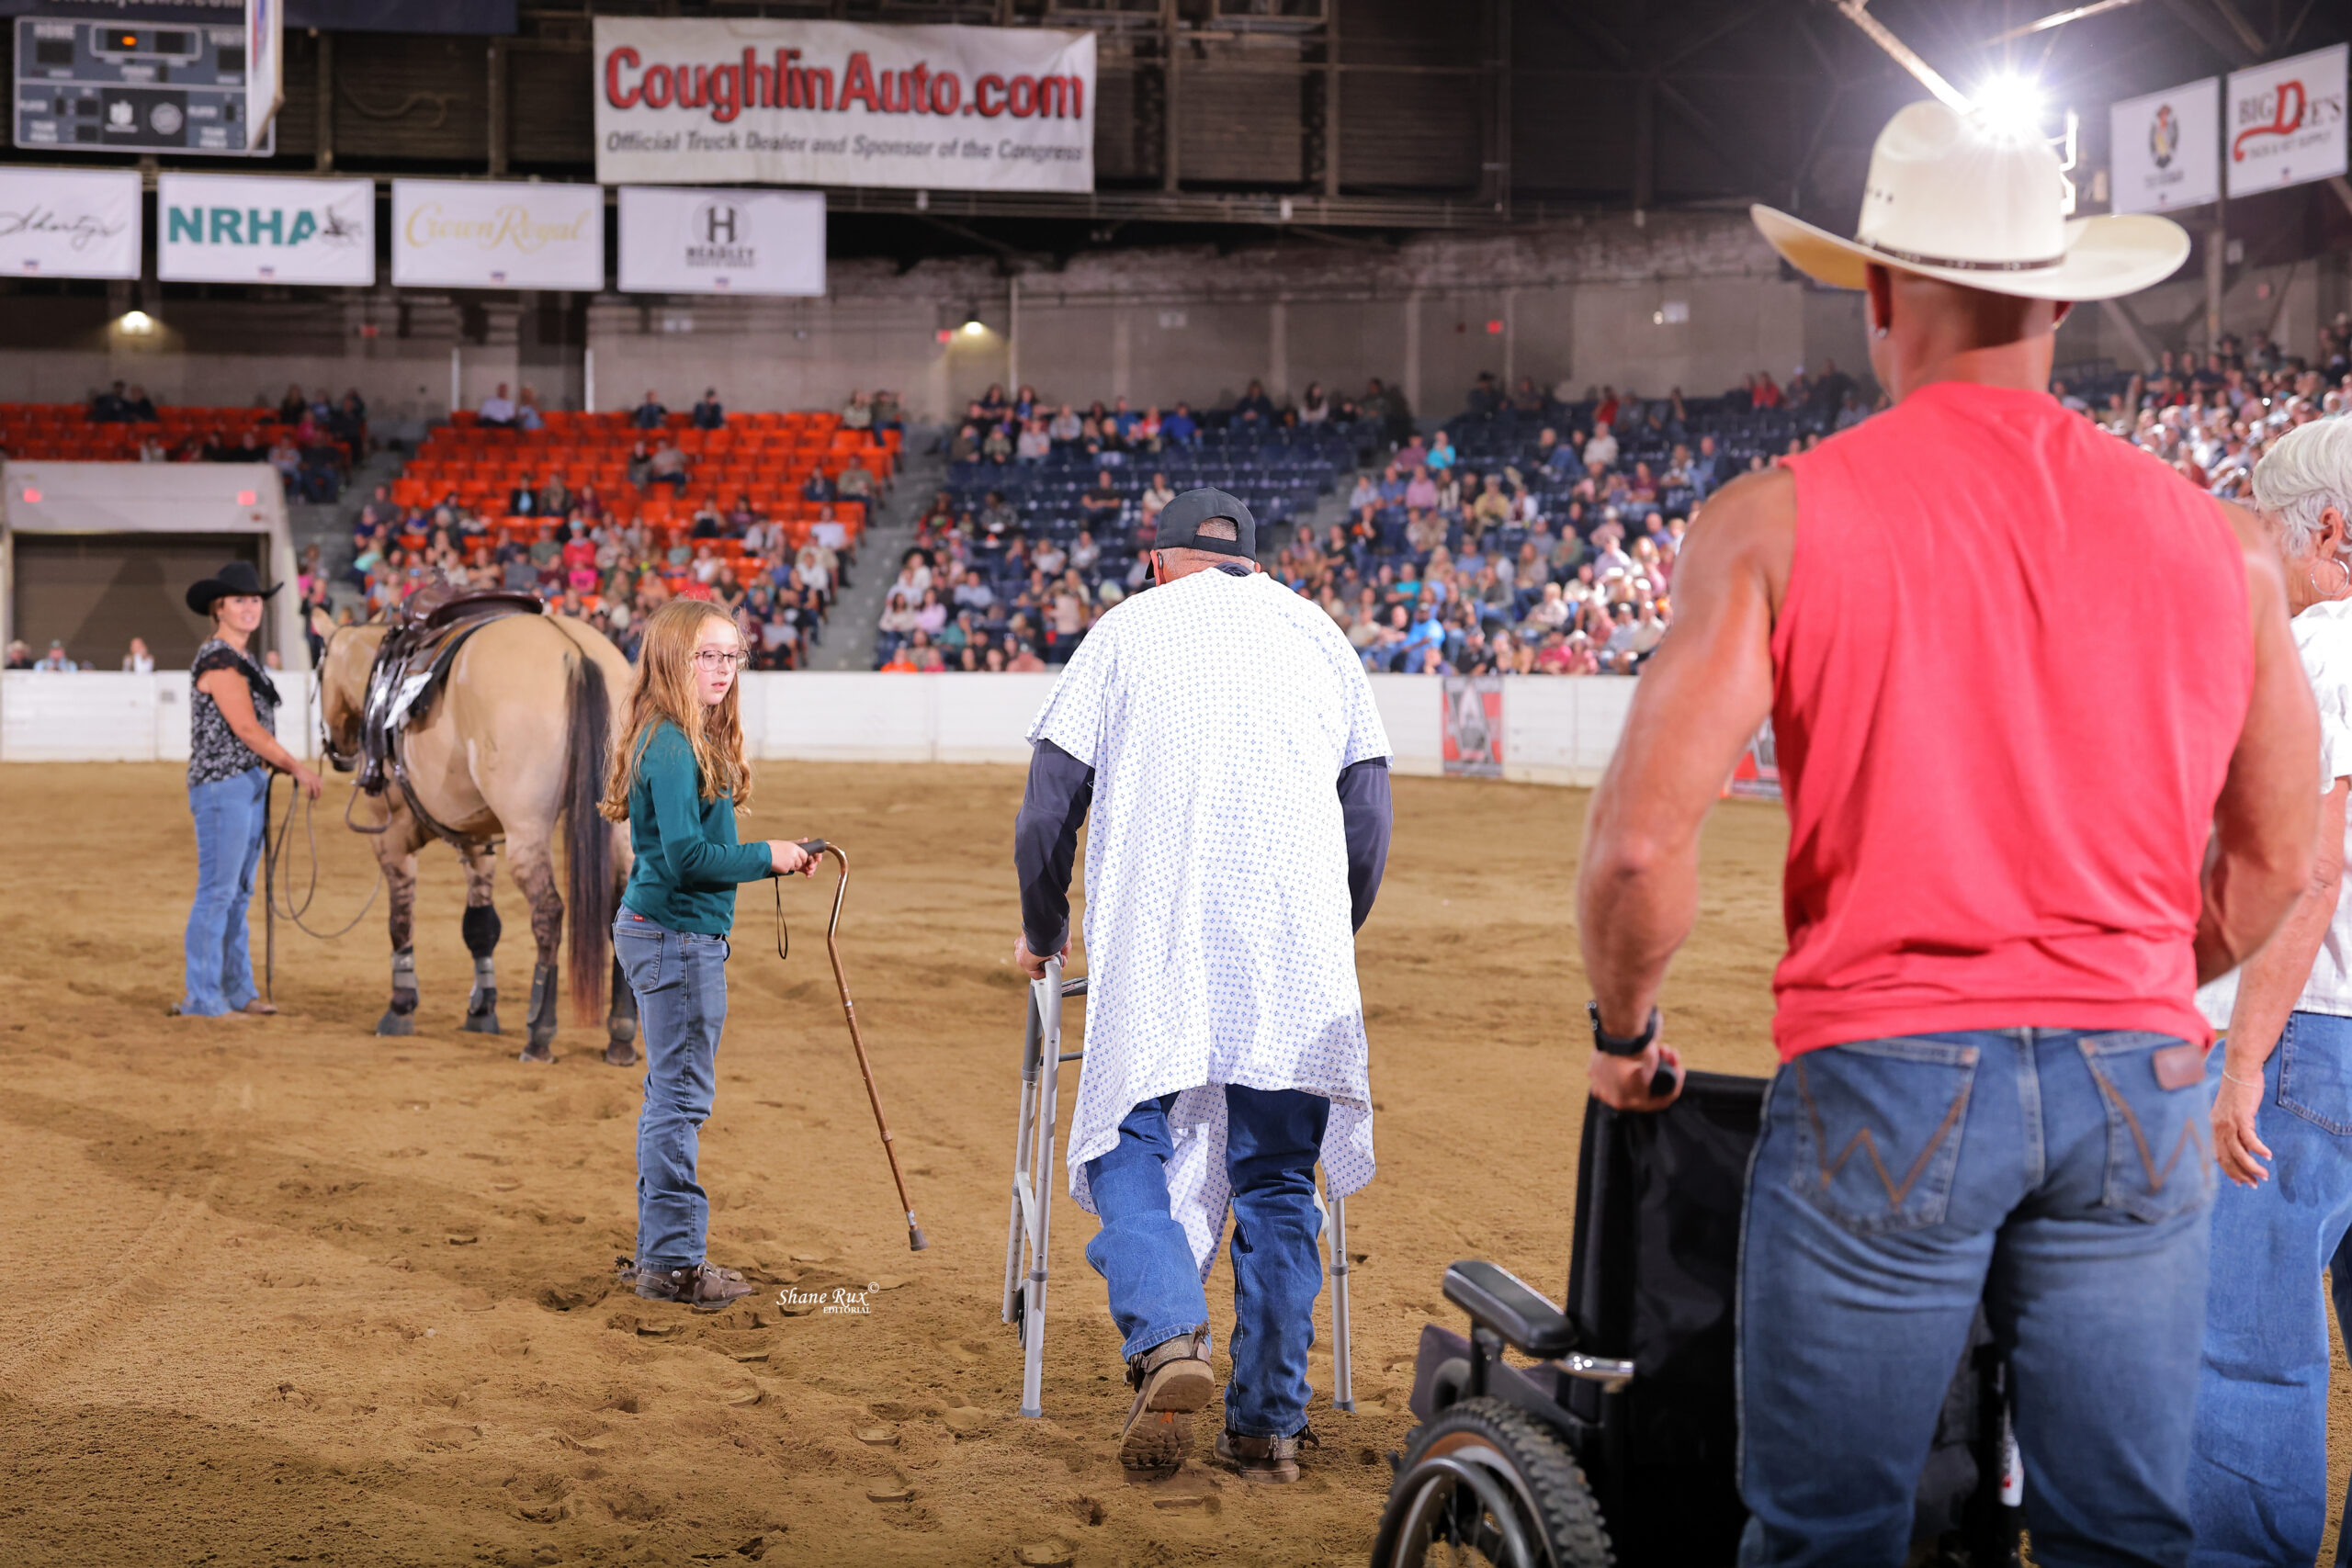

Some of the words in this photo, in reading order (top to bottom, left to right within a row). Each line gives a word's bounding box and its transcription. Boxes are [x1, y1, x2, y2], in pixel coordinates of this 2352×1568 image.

[605, 46, 1082, 123] CoughlinAuto.com
[2239, 93, 2274, 125] BIG
[606, 131, 680, 152] Official
[686, 131, 739, 151] Truck
[745, 132, 806, 152] Dealer
[810, 135, 848, 153] and
[853, 135, 933, 159] Sponsor
[937, 137, 957, 157] of
[962, 139, 992, 158] the
[998, 140, 1083, 163] Congress
[168, 206, 317, 246] NRHA
[405, 201, 495, 249] Crown
[481, 203, 591, 254] Royal
[707, 206, 736, 243] H
